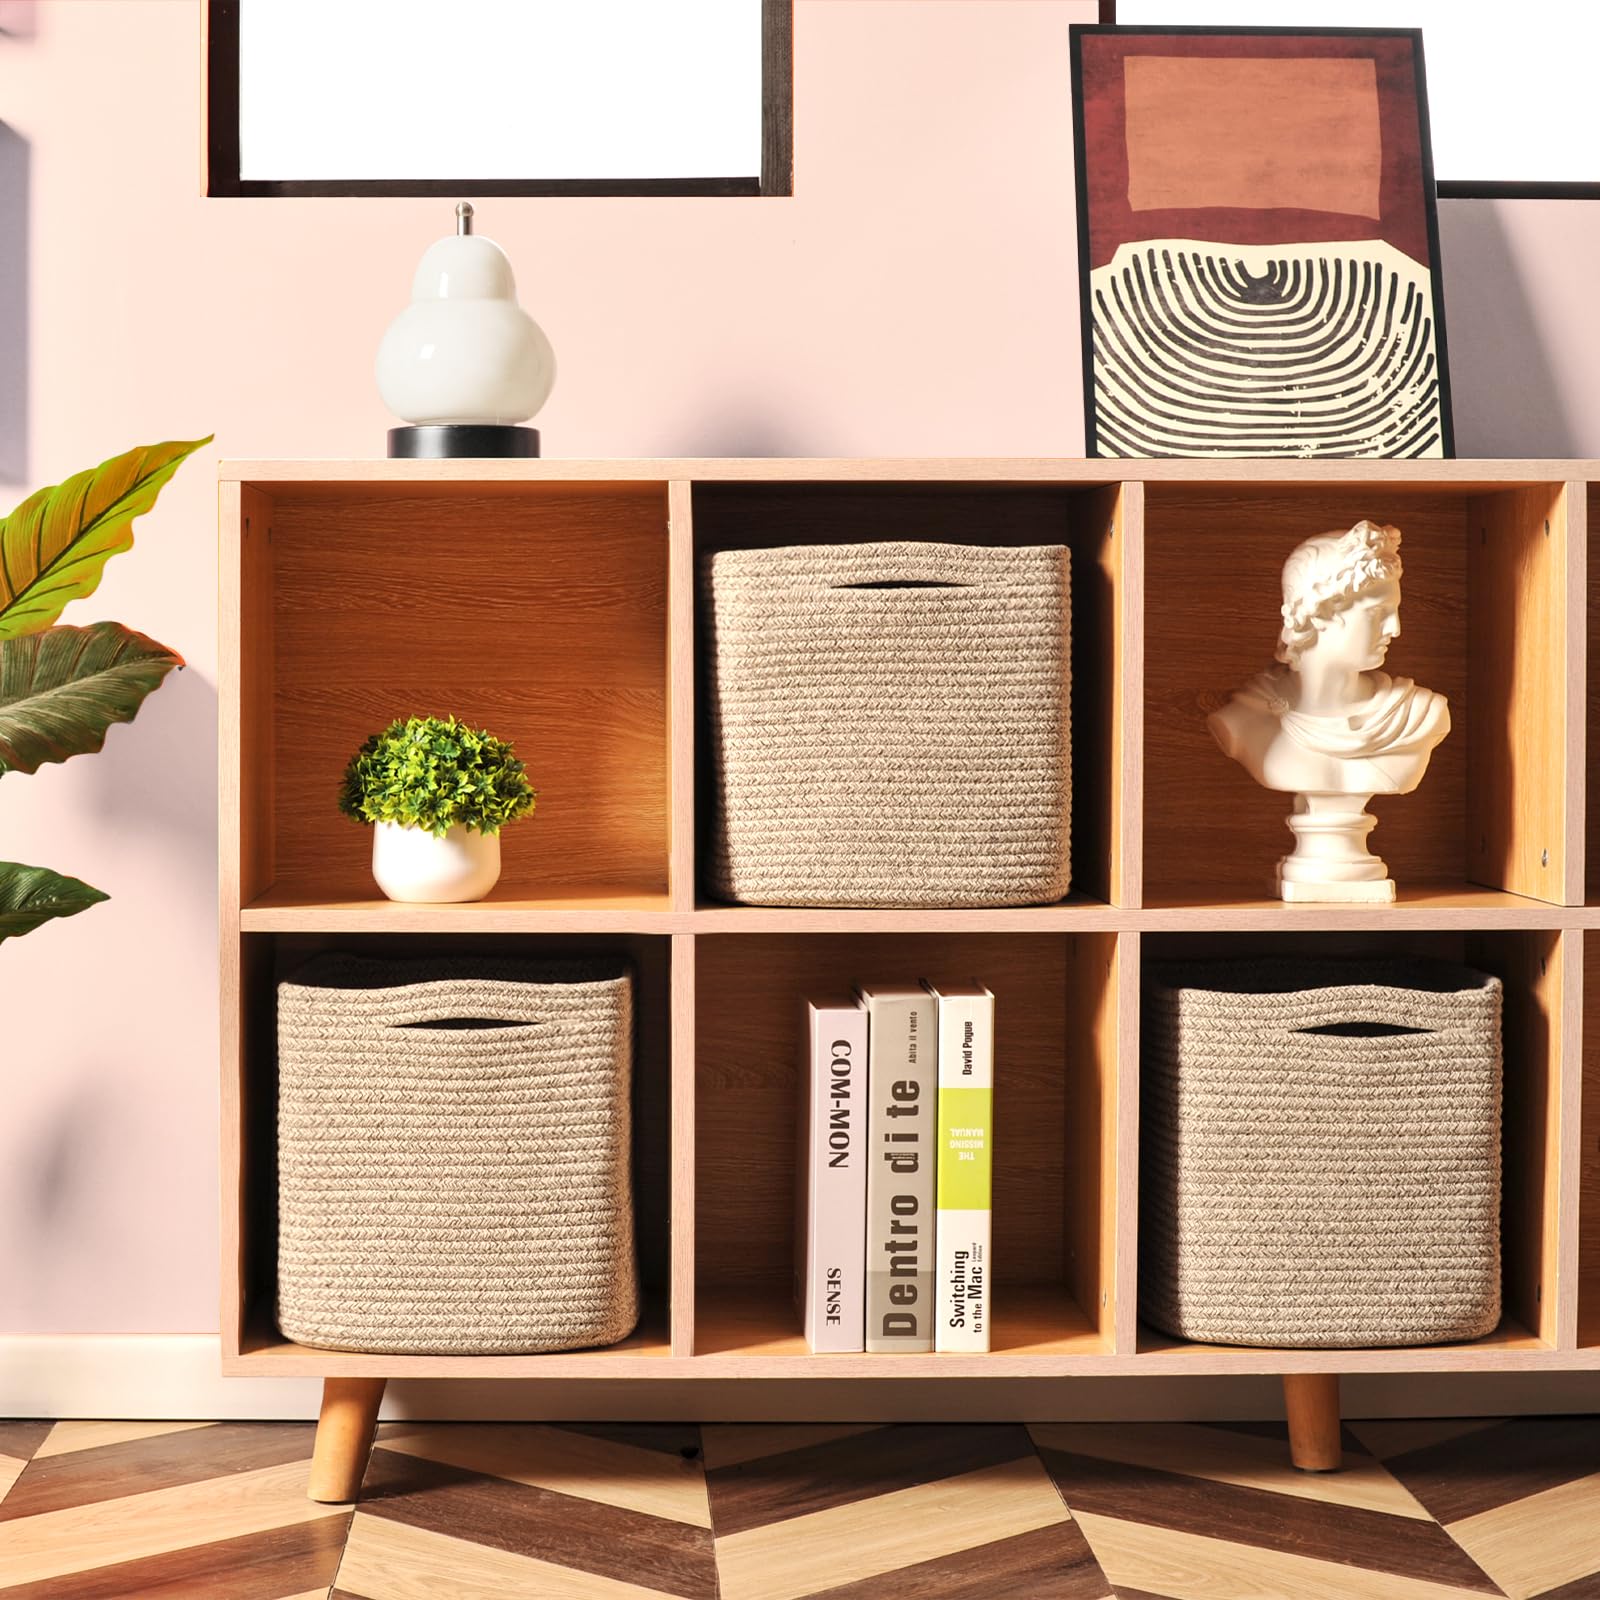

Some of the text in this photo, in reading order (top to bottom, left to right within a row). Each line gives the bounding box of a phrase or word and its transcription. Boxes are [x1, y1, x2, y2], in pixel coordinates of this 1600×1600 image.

[909, 1011, 917, 1032] vento
[962, 1021, 974, 1075] David Pogue
[829, 1040, 852, 1168] COM-MON
[886, 1080, 920, 1118] te
[884, 1133, 919, 1173] di
[949, 1128, 984, 1137] MANUAL
[949, 1139, 984, 1149] MISSING
[958, 1152, 976, 1161] THE
[882, 1195, 919, 1336] Dentro
[826, 1268, 842, 1326] SENSE
[949, 1251, 969, 1328] Switching
[967, 1267, 982, 1333] to the Mac
